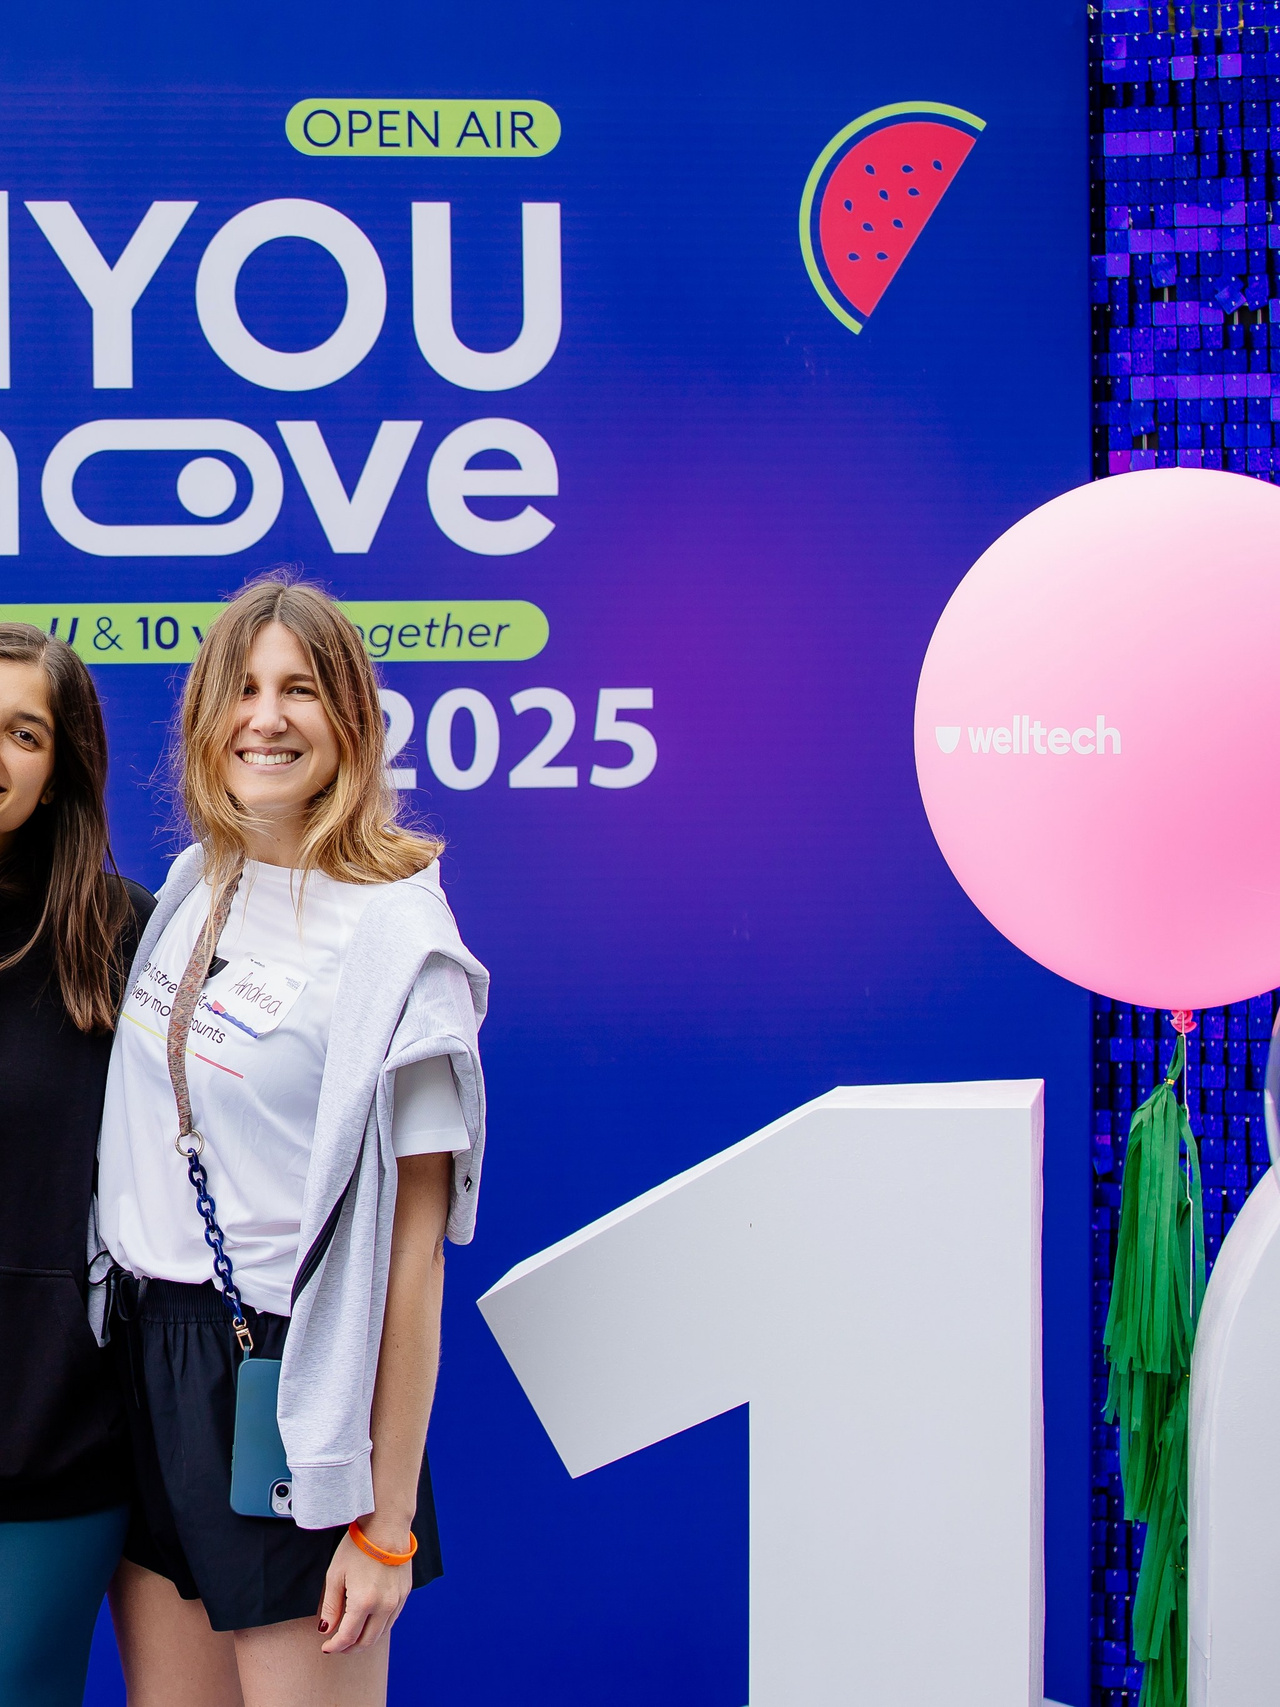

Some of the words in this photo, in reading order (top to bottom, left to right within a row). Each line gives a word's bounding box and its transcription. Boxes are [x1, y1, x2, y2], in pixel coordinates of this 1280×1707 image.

[303, 109, 440, 148] OPEN
[456, 111, 540, 149] AIR
[93, 616, 124, 651] &
[136, 616, 180, 650] 10
[355, 612, 511, 658] gether
[378, 686, 658, 791] 2025
[967, 714, 1122, 755] welltech
[228, 972, 283, 1017] Andrea
[189, 1017, 226, 1044] ounts
